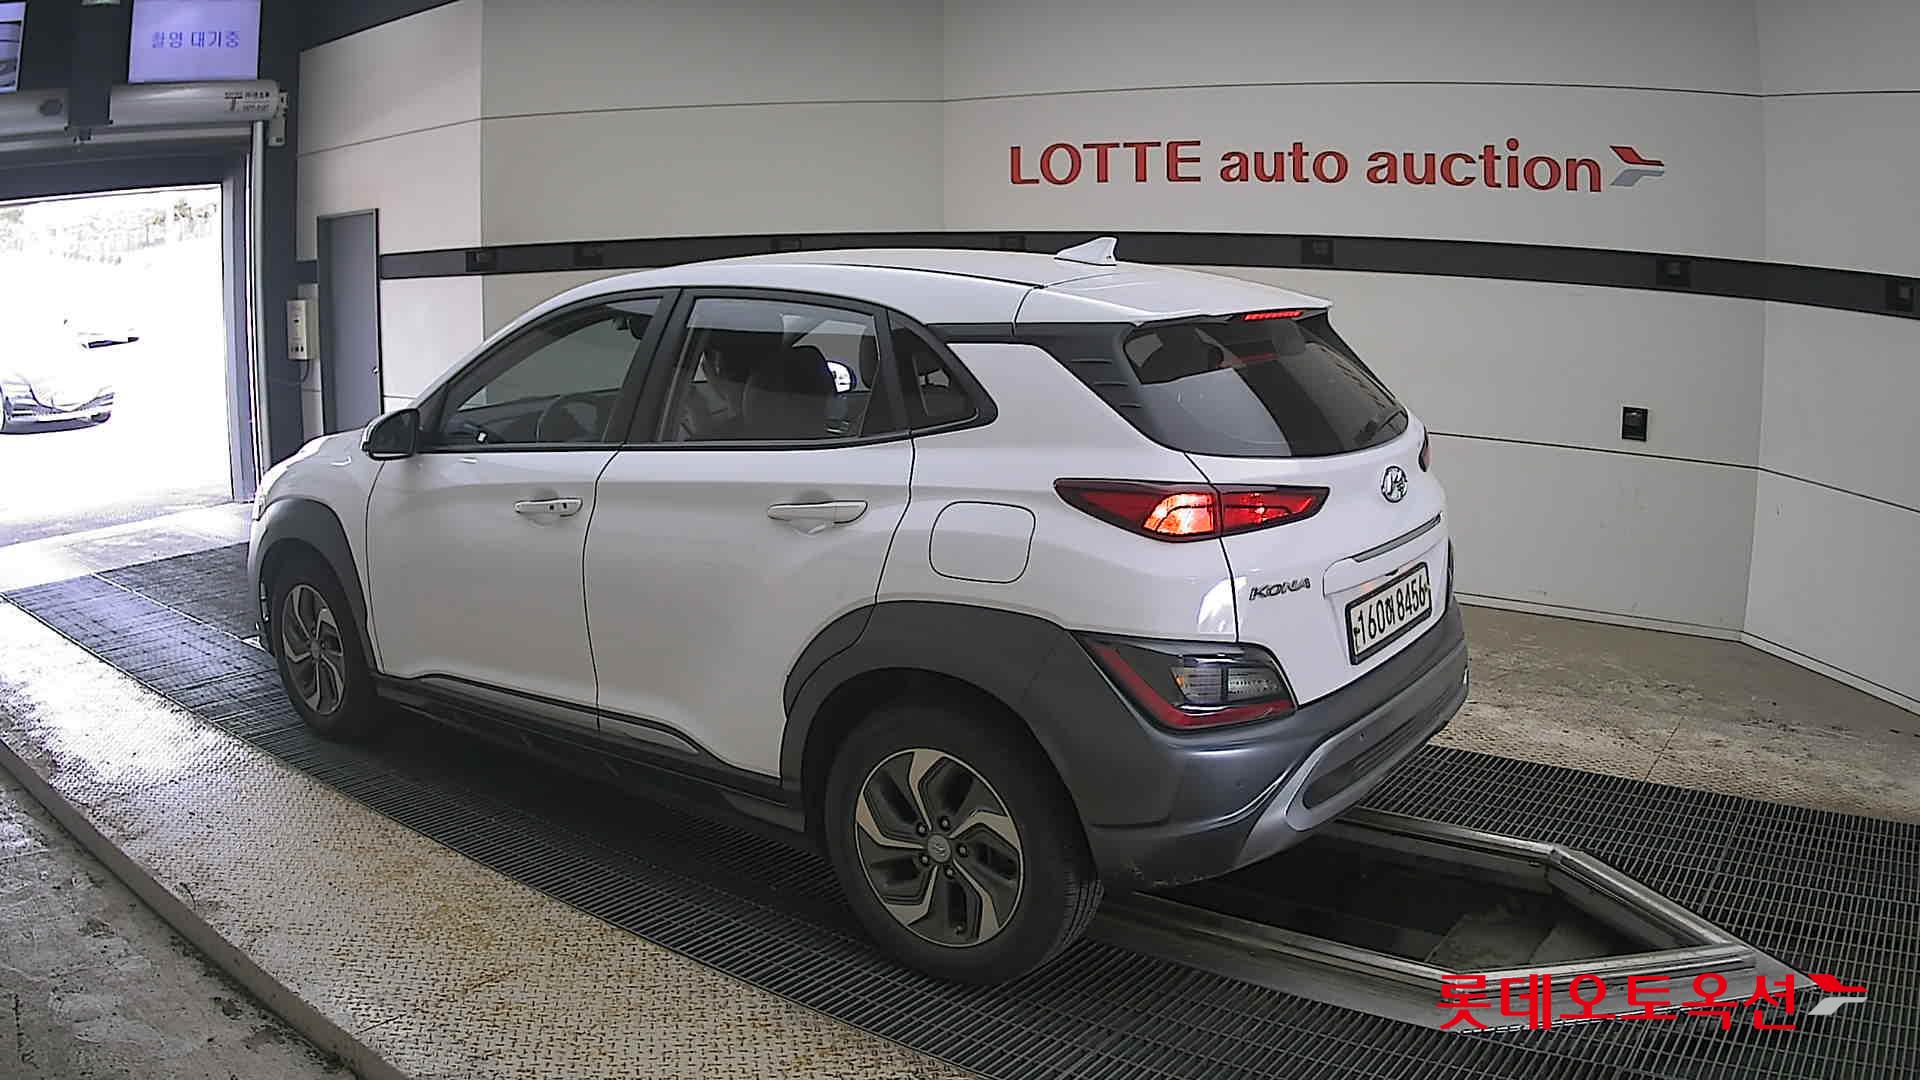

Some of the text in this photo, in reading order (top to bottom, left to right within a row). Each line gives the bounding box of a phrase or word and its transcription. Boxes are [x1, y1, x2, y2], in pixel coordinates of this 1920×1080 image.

[1010, 138, 1602, 193] LOTTE auto auction
[1248, 577, 1311, 601] KONA
